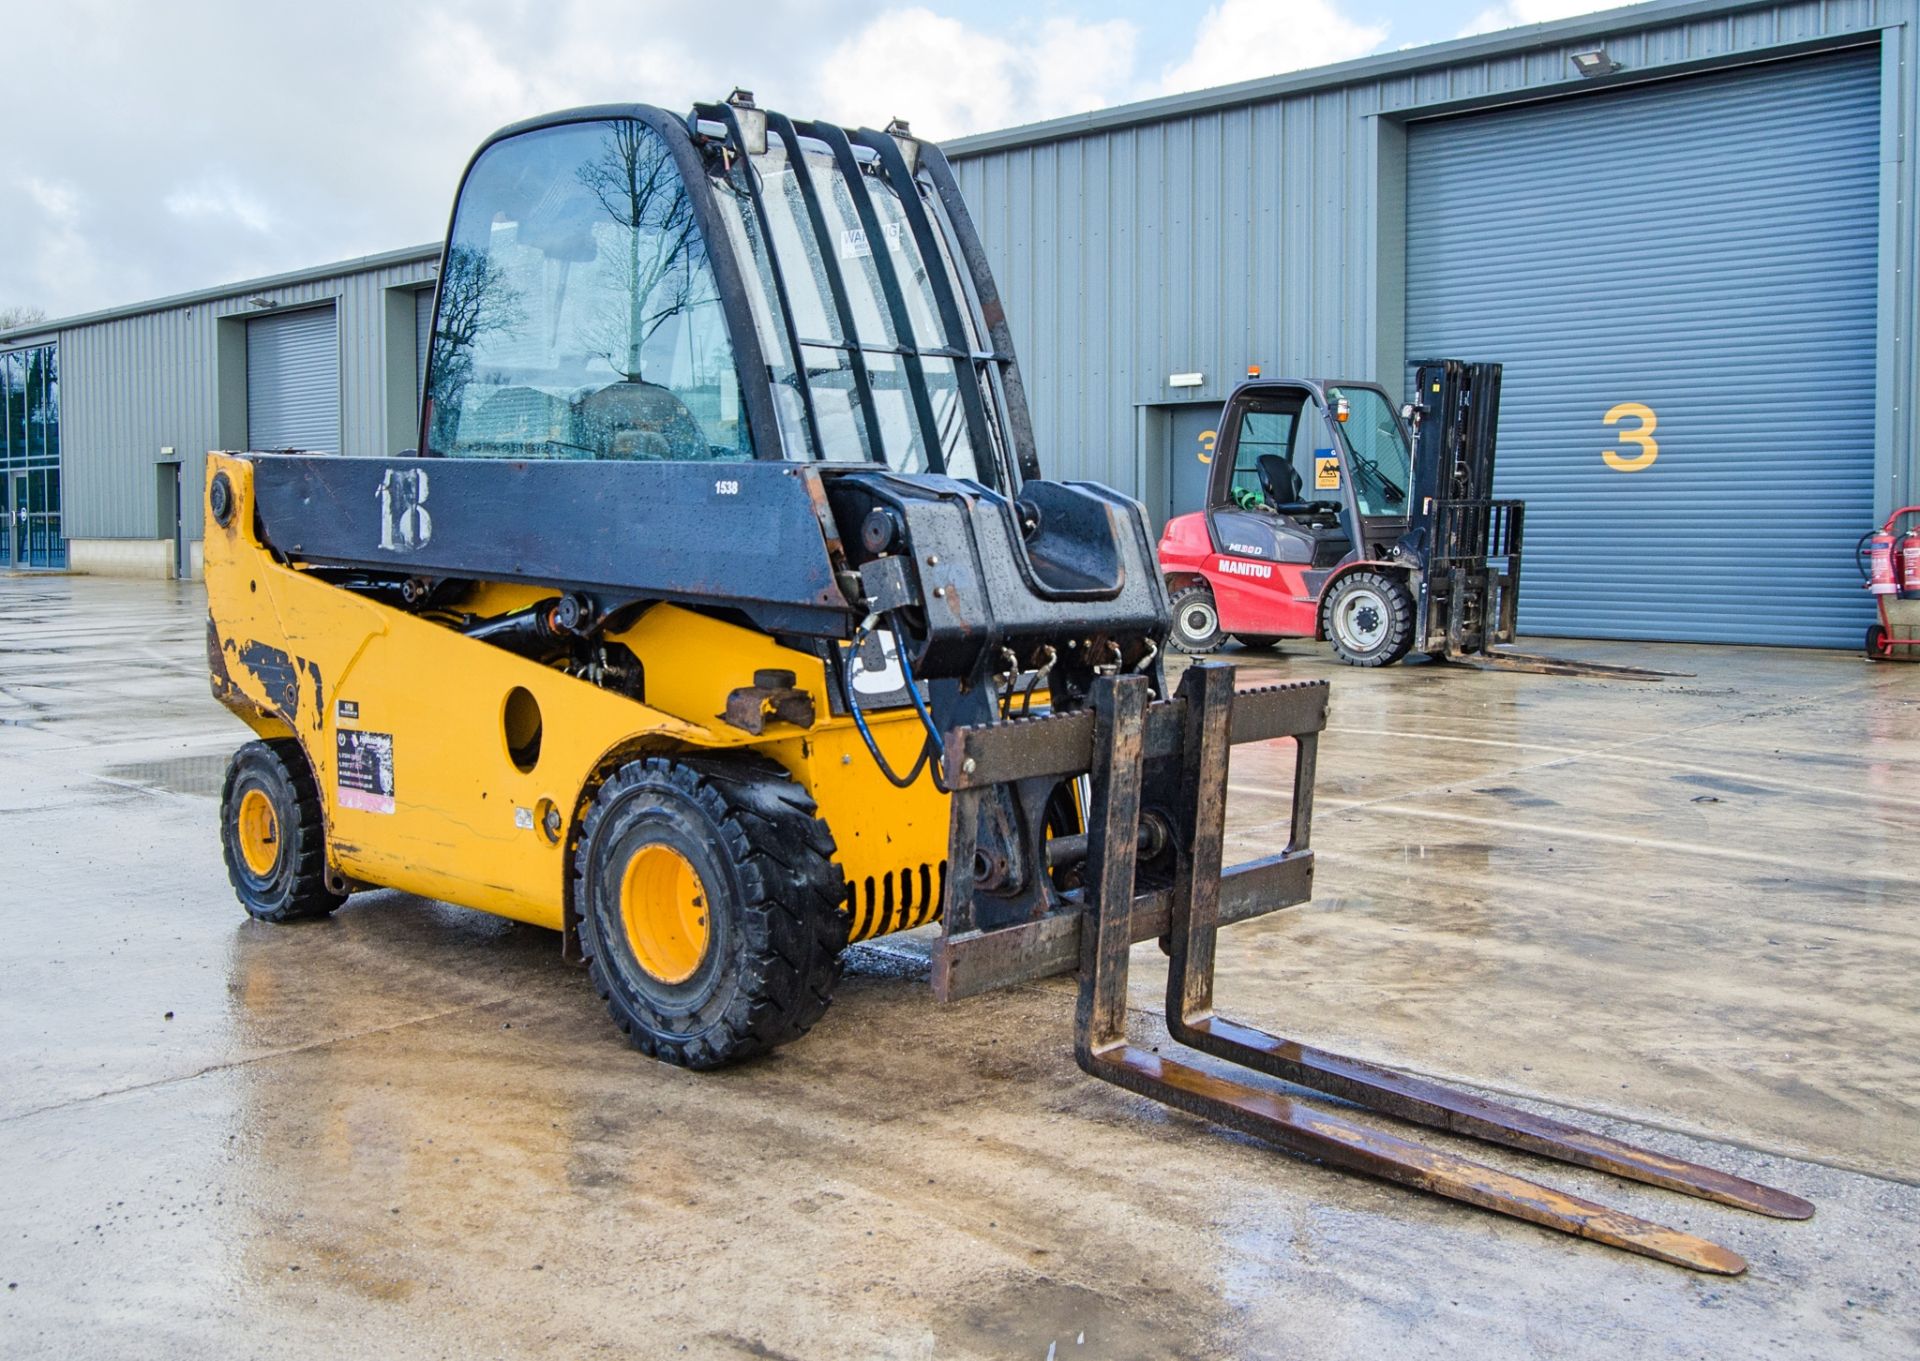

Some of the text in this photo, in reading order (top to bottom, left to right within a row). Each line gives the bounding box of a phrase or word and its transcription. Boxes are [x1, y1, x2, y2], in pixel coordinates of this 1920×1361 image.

[1197, 430, 1217, 464] 3
[1601, 402, 1659, 472] 3
[714, 480, 739, 495] 1538
[1218, 559, 1272, 579] MANITOU
